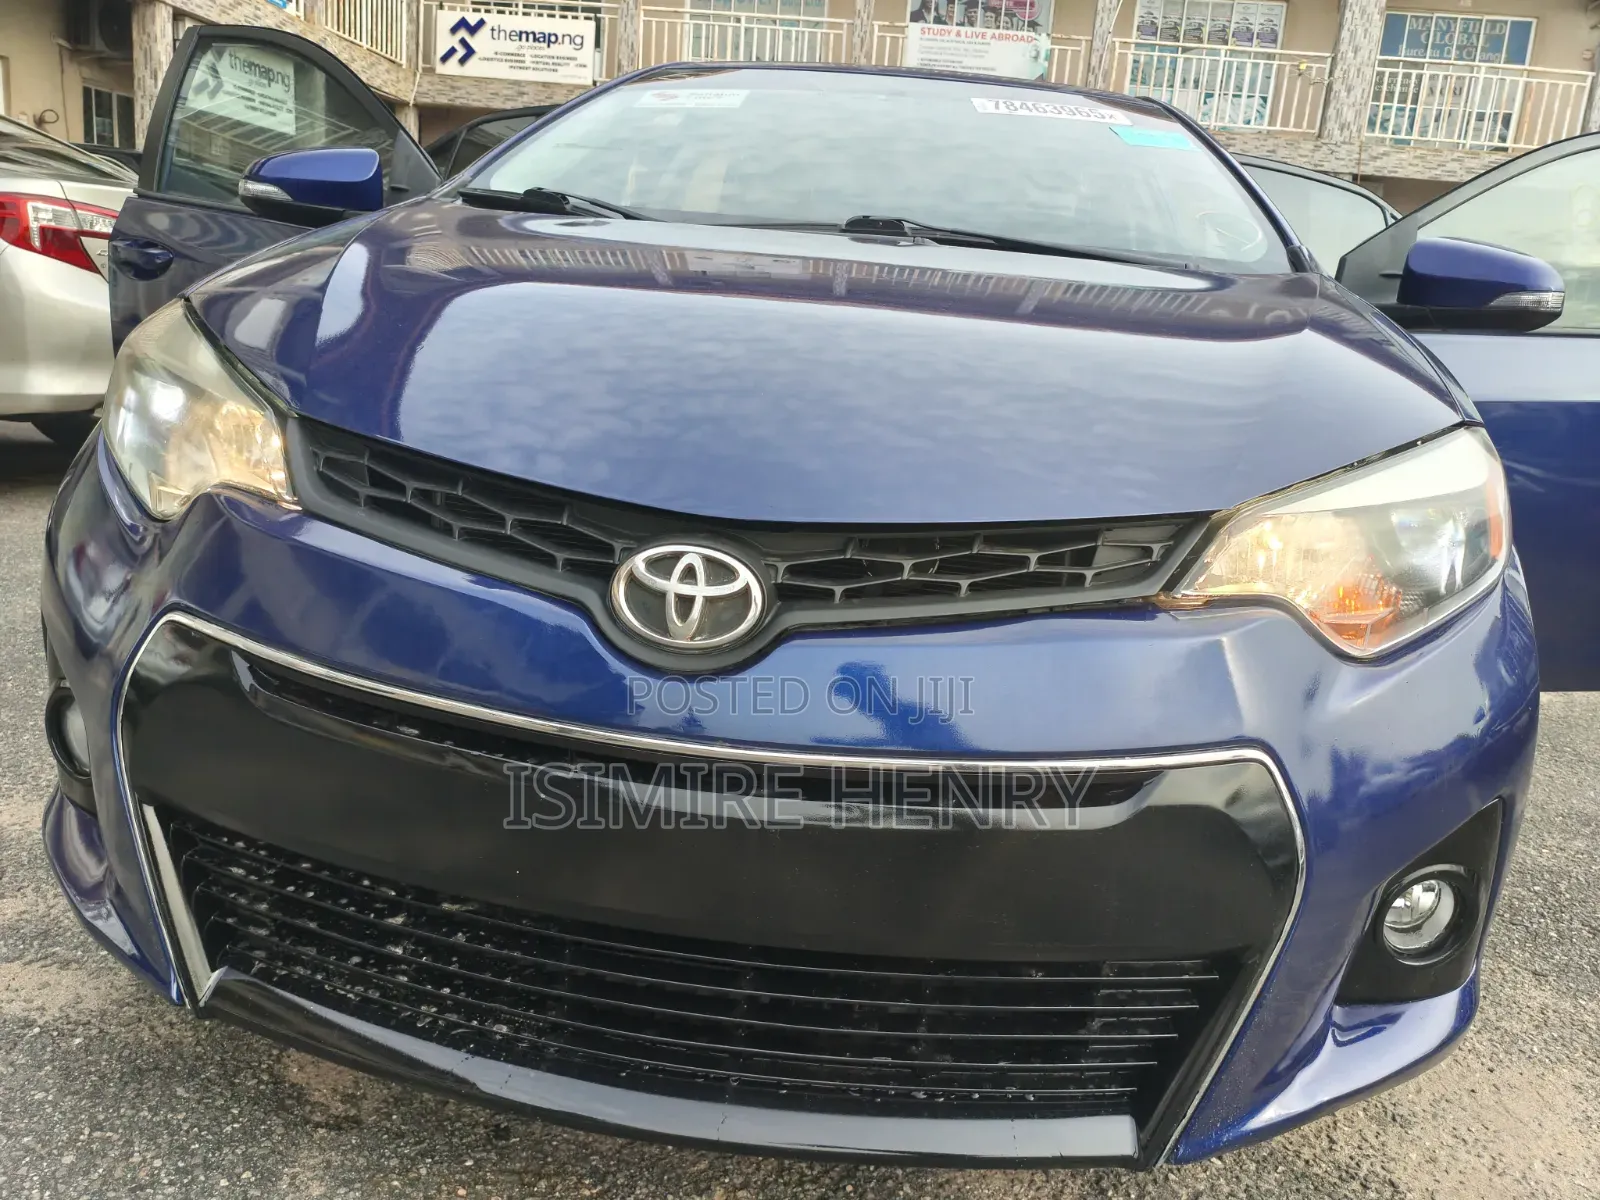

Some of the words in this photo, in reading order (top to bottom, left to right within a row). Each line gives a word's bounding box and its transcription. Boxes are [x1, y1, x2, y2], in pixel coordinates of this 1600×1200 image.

[920, 26, 954, 37] STUDY
[965, 30, 987, 40] LIVE
[989, 32, 1035, 43] ABROAD
[1409, 17, 1506, 35] MANYFILD
[490, 24, 584, 51] themap.ng
